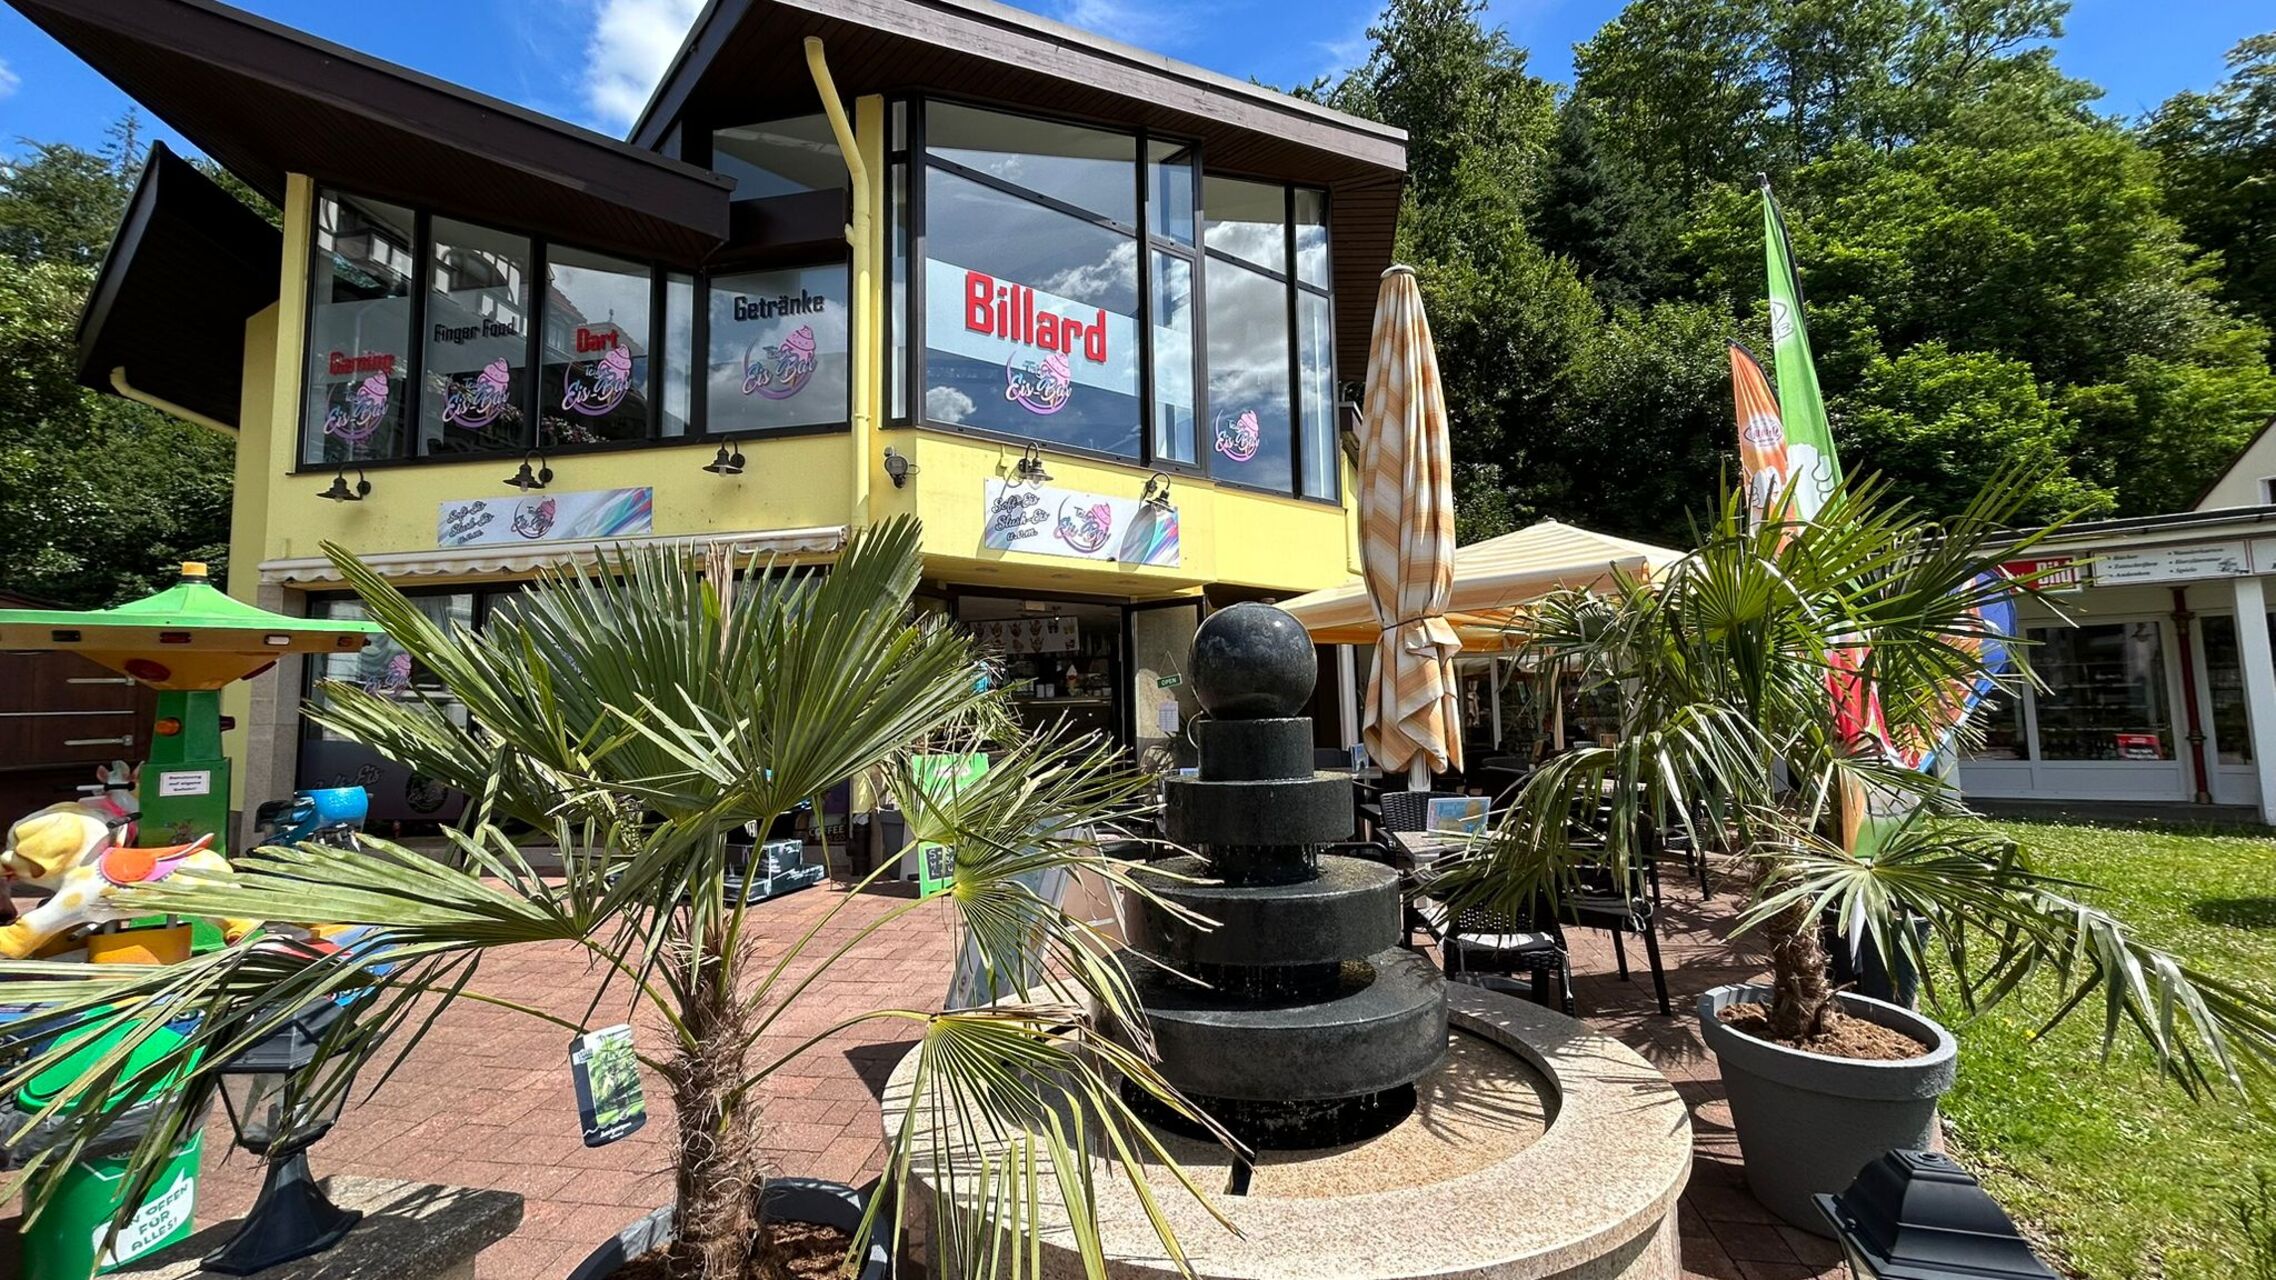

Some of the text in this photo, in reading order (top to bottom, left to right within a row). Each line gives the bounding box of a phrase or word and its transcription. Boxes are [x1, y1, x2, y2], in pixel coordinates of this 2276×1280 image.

[733, 288, 826, 321] Getränke
[965, 270, 1107, 364] Billard
[434, 316, 518, 345] Finger Food
[576, 326, 619, 353] Dart
[329, 351, 396, 376] Gaming
[991, 492, 1041, 515] Soft-Eis
[995, 508, 1051, 531] Slush-Eis
[1160, 677, 1177, 686] OPEN
[808, 825, 845, 839] COFEE
[146, 1183, 188, 1217] OFFEN
